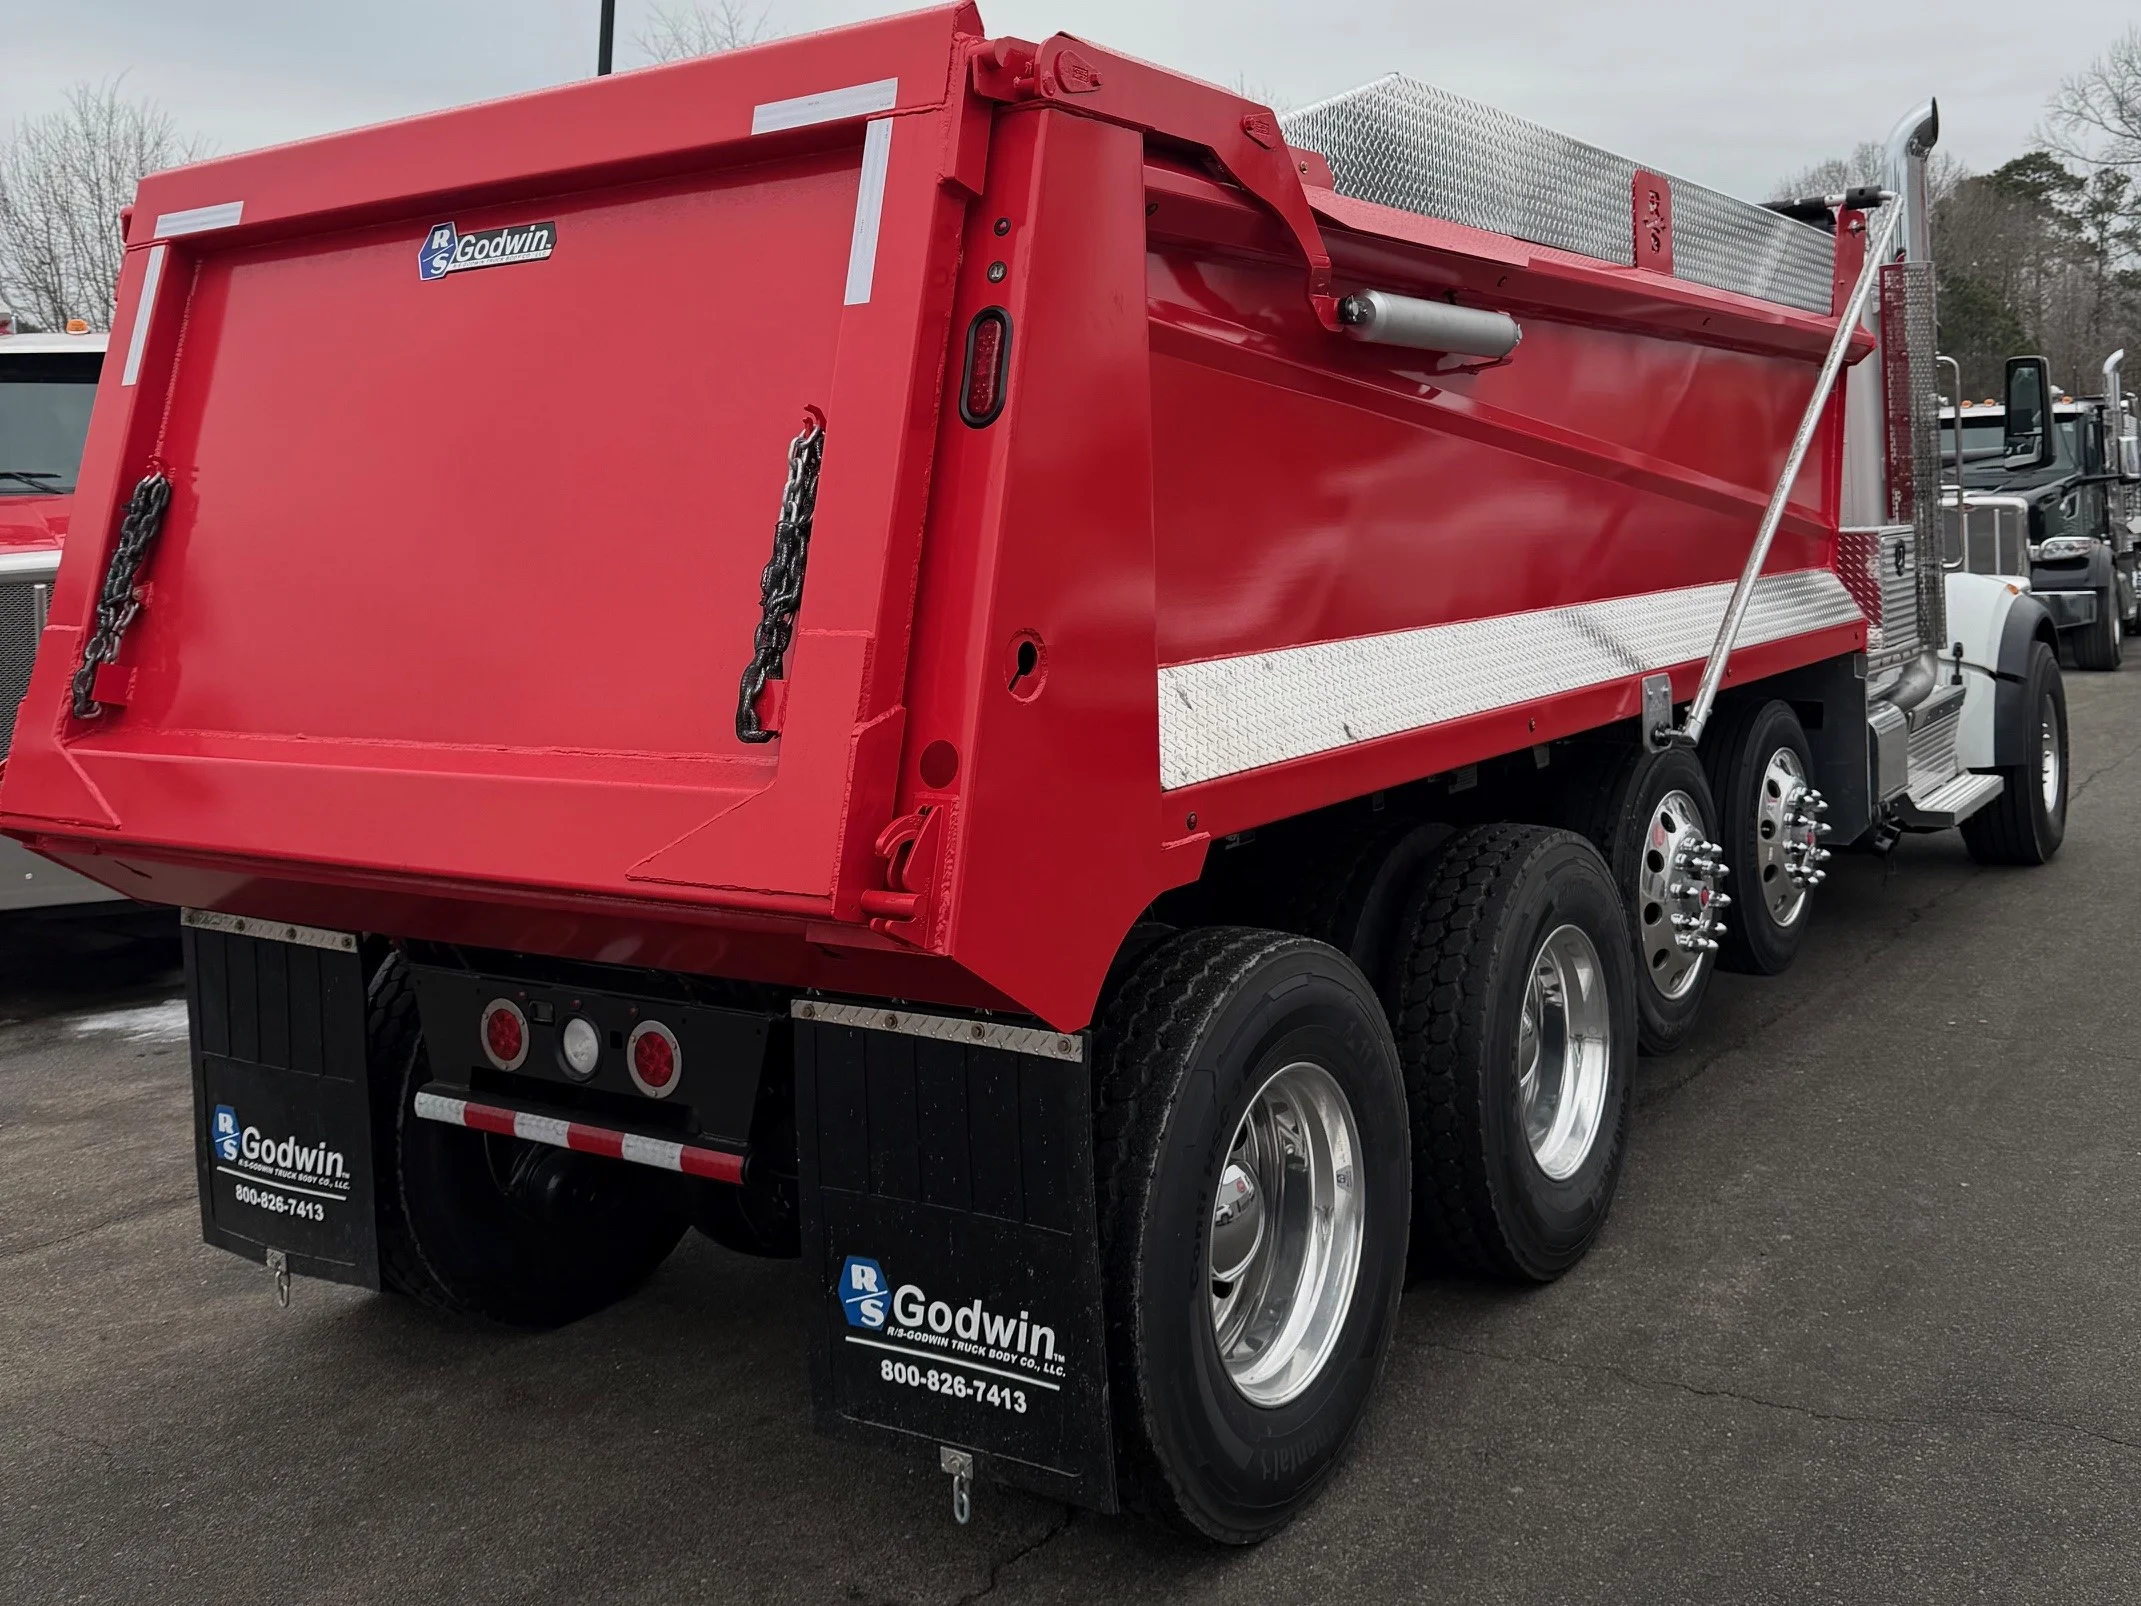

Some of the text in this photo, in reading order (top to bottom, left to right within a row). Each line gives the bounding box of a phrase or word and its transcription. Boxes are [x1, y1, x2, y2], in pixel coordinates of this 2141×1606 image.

[456, 225, 548, 261] Godwin
[242, 1126, 344, 1178] Godwin
[274, 1168, 297, 1180] TRUCK
[298, 1174, 318, 1184] BODY
[235, 1183, 325, 1222] 800-826-7413
[893, 1284, 1056, 1360] Godwin
[887, 1326, 1066, 1378] R/S-GODWIN TRUCK BODY CO., LLC.
[881, 1359, 1027, 1414] 800-826-7413
